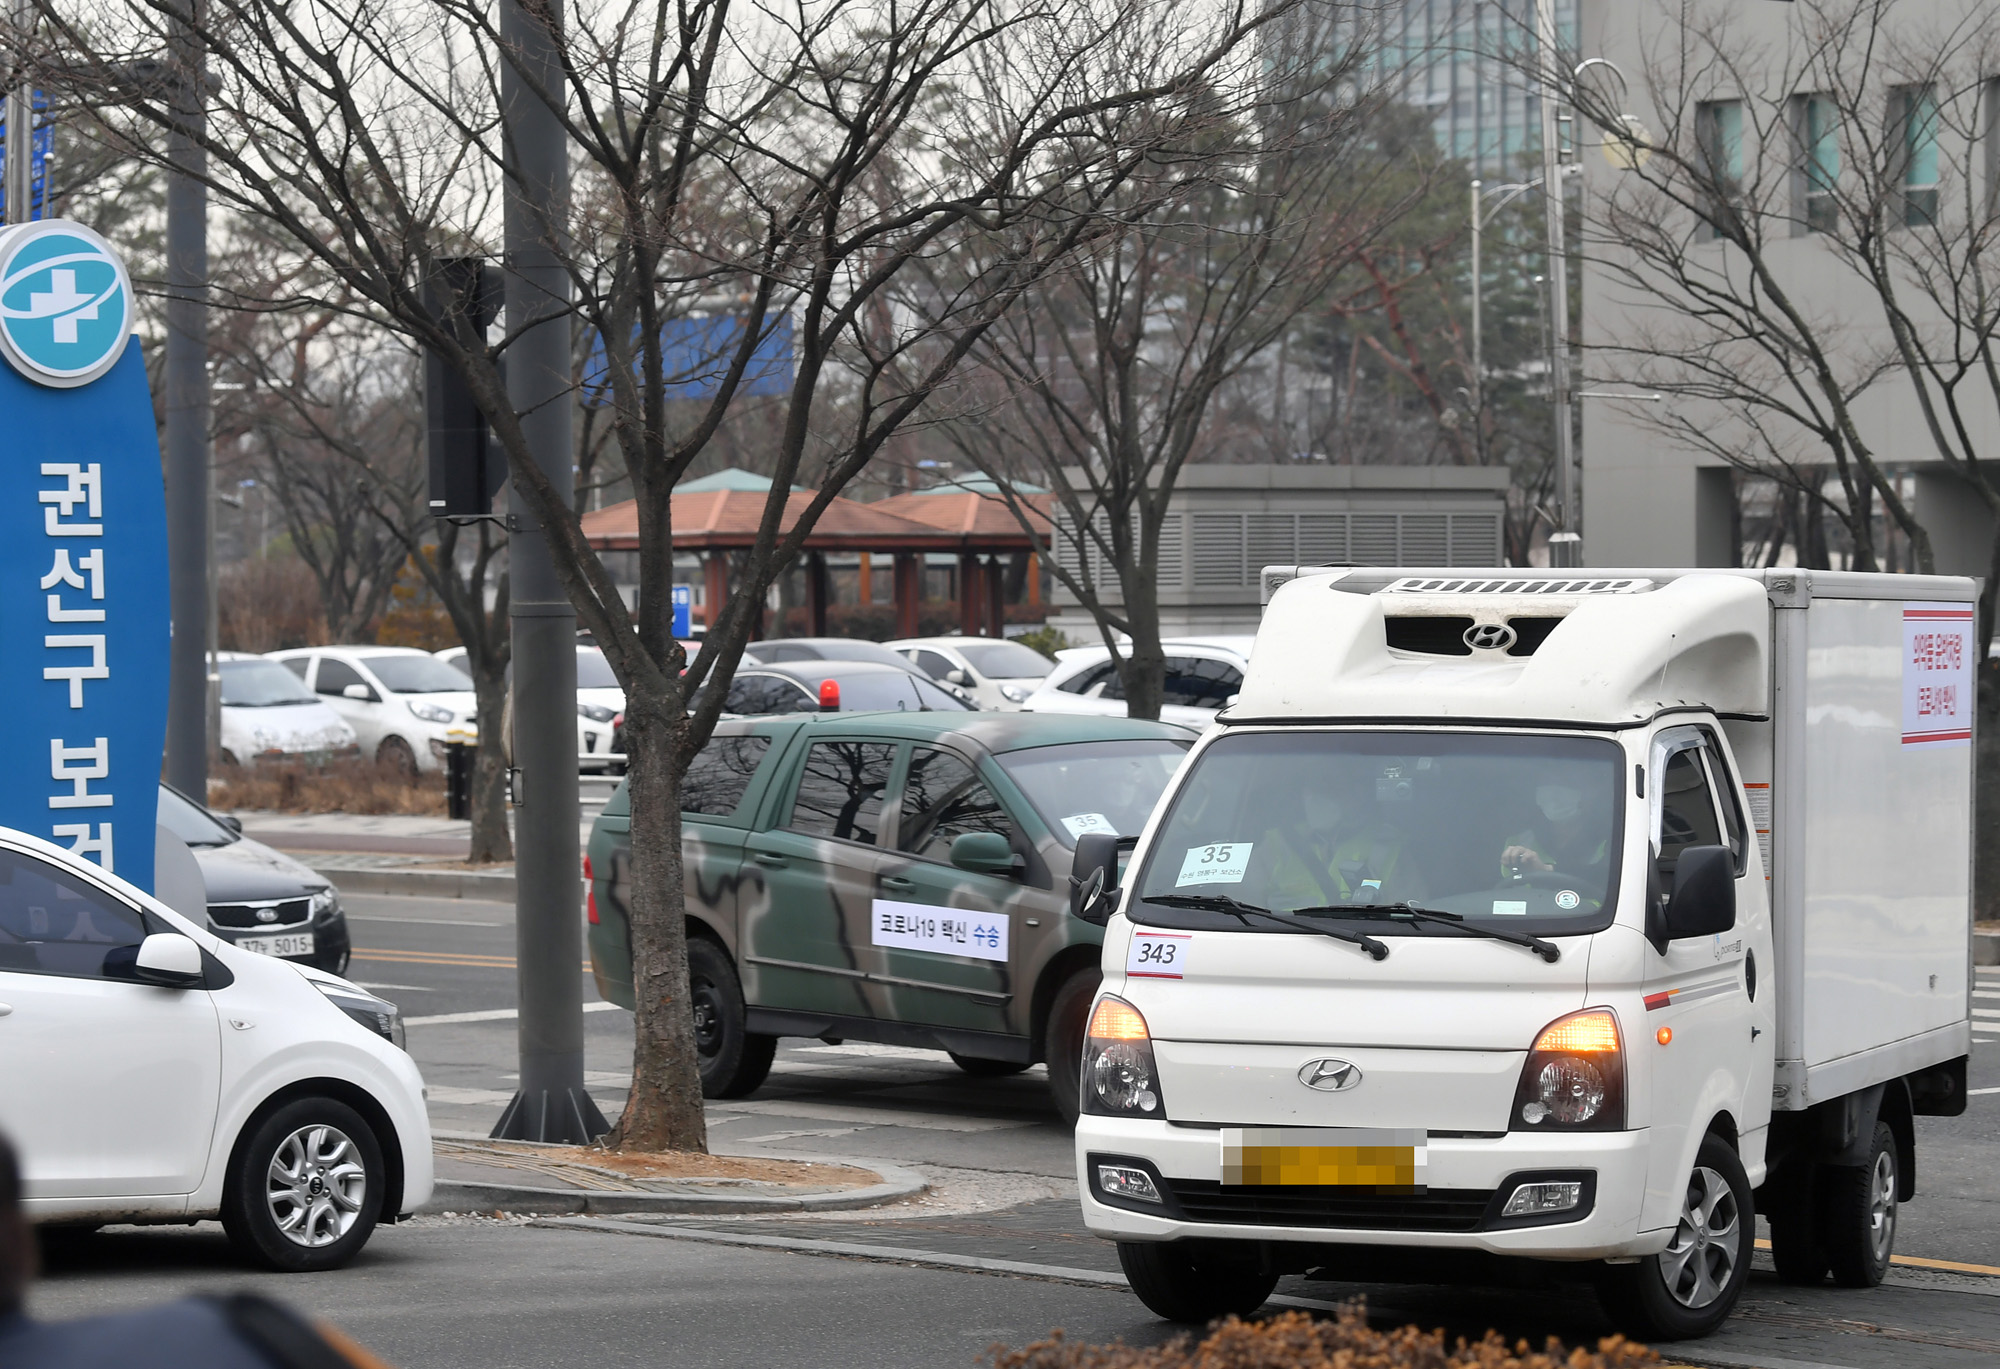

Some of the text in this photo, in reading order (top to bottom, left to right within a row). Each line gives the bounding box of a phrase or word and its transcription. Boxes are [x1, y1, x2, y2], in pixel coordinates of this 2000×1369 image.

[38, 462, 110, 709] 권선구
[1075, 815, 1098, 828] 35
[1200, 845, 1233, 864] 35
[1220, 868, 1242, 876] 보건소
[880, 914, 1000, 948] 코로나19 백신 수송
[275, 937, 308, 954] 5015
[1137, 942, 1177, 964] 343
